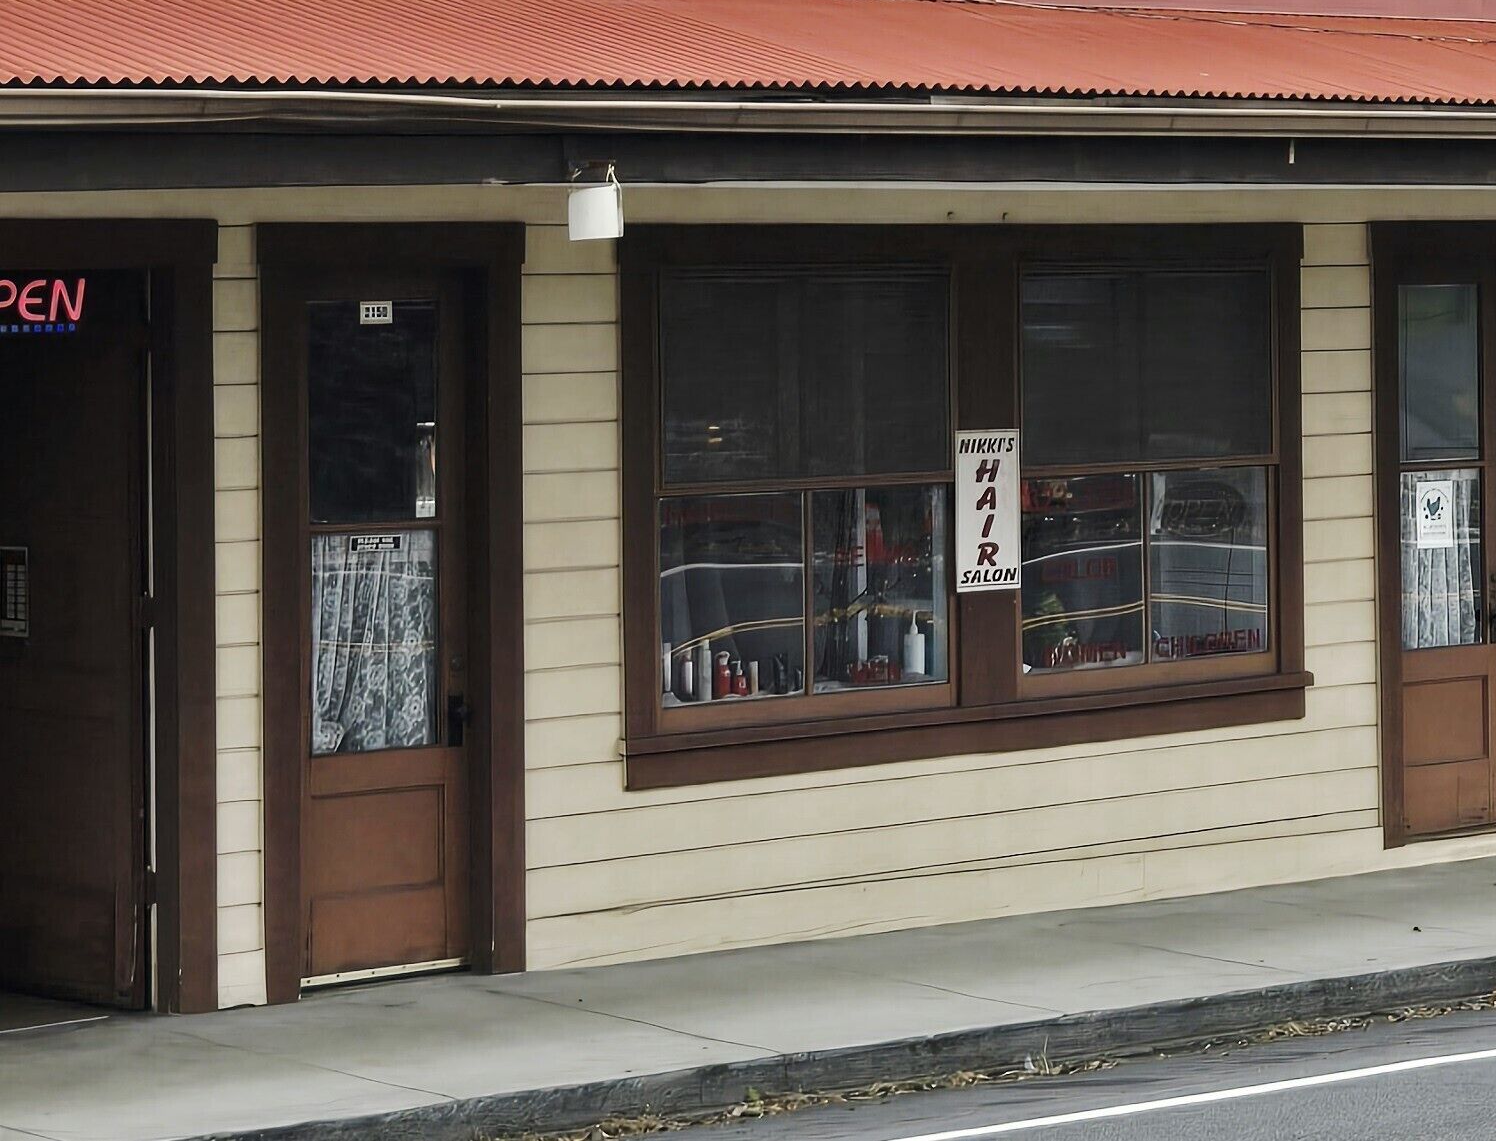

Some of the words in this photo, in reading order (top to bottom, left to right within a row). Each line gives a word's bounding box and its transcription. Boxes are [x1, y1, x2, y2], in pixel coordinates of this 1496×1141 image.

[959, 437, 1015, 454] NIKKI'S
[975, 458, 1000, 567] HAIR
[960, 567, 1017, 585] SALON
